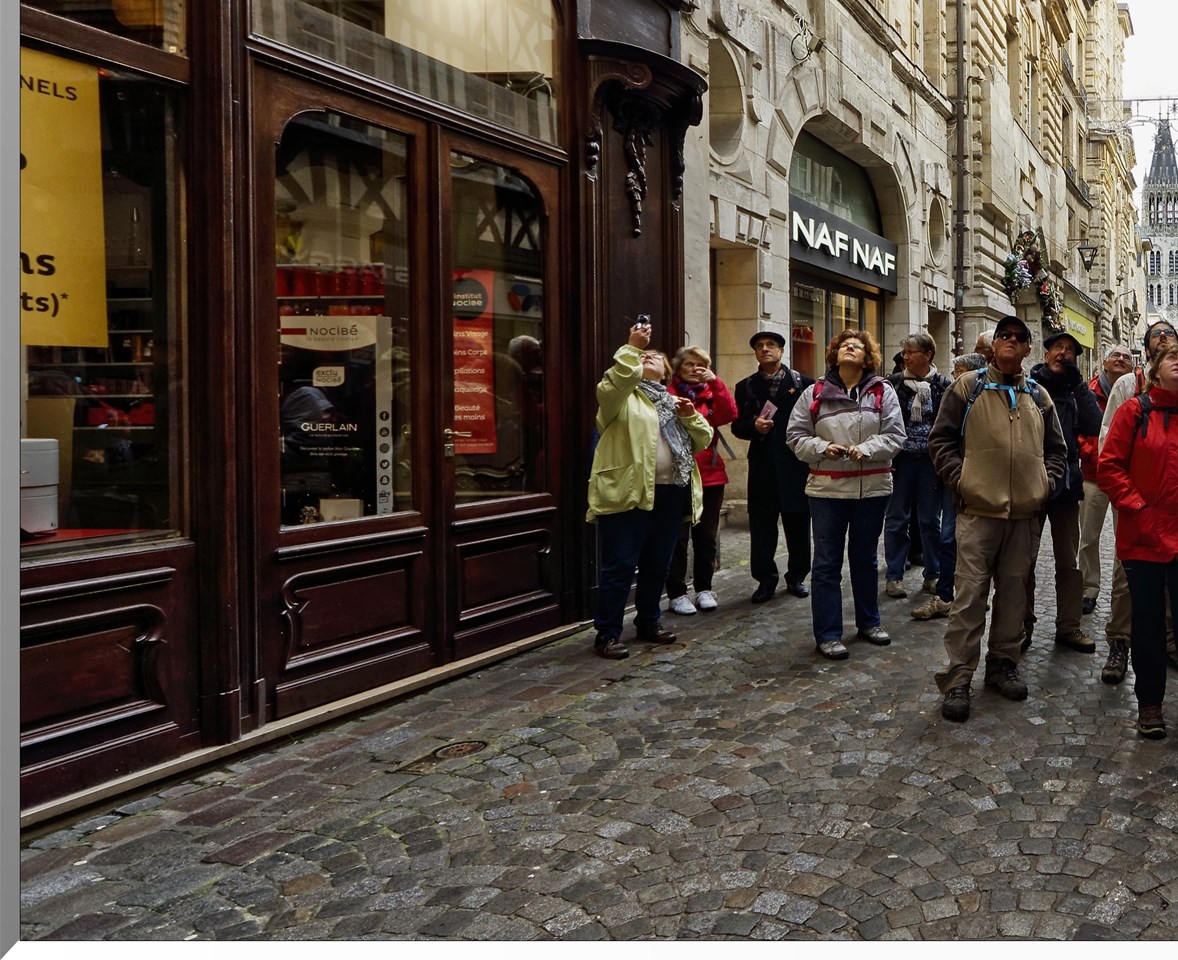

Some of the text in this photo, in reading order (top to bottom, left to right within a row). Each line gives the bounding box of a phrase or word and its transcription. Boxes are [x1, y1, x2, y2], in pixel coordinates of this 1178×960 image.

[793, 211, 895, 277] NAF NAF
[301, 422, 358, 432] GUERLAIN
